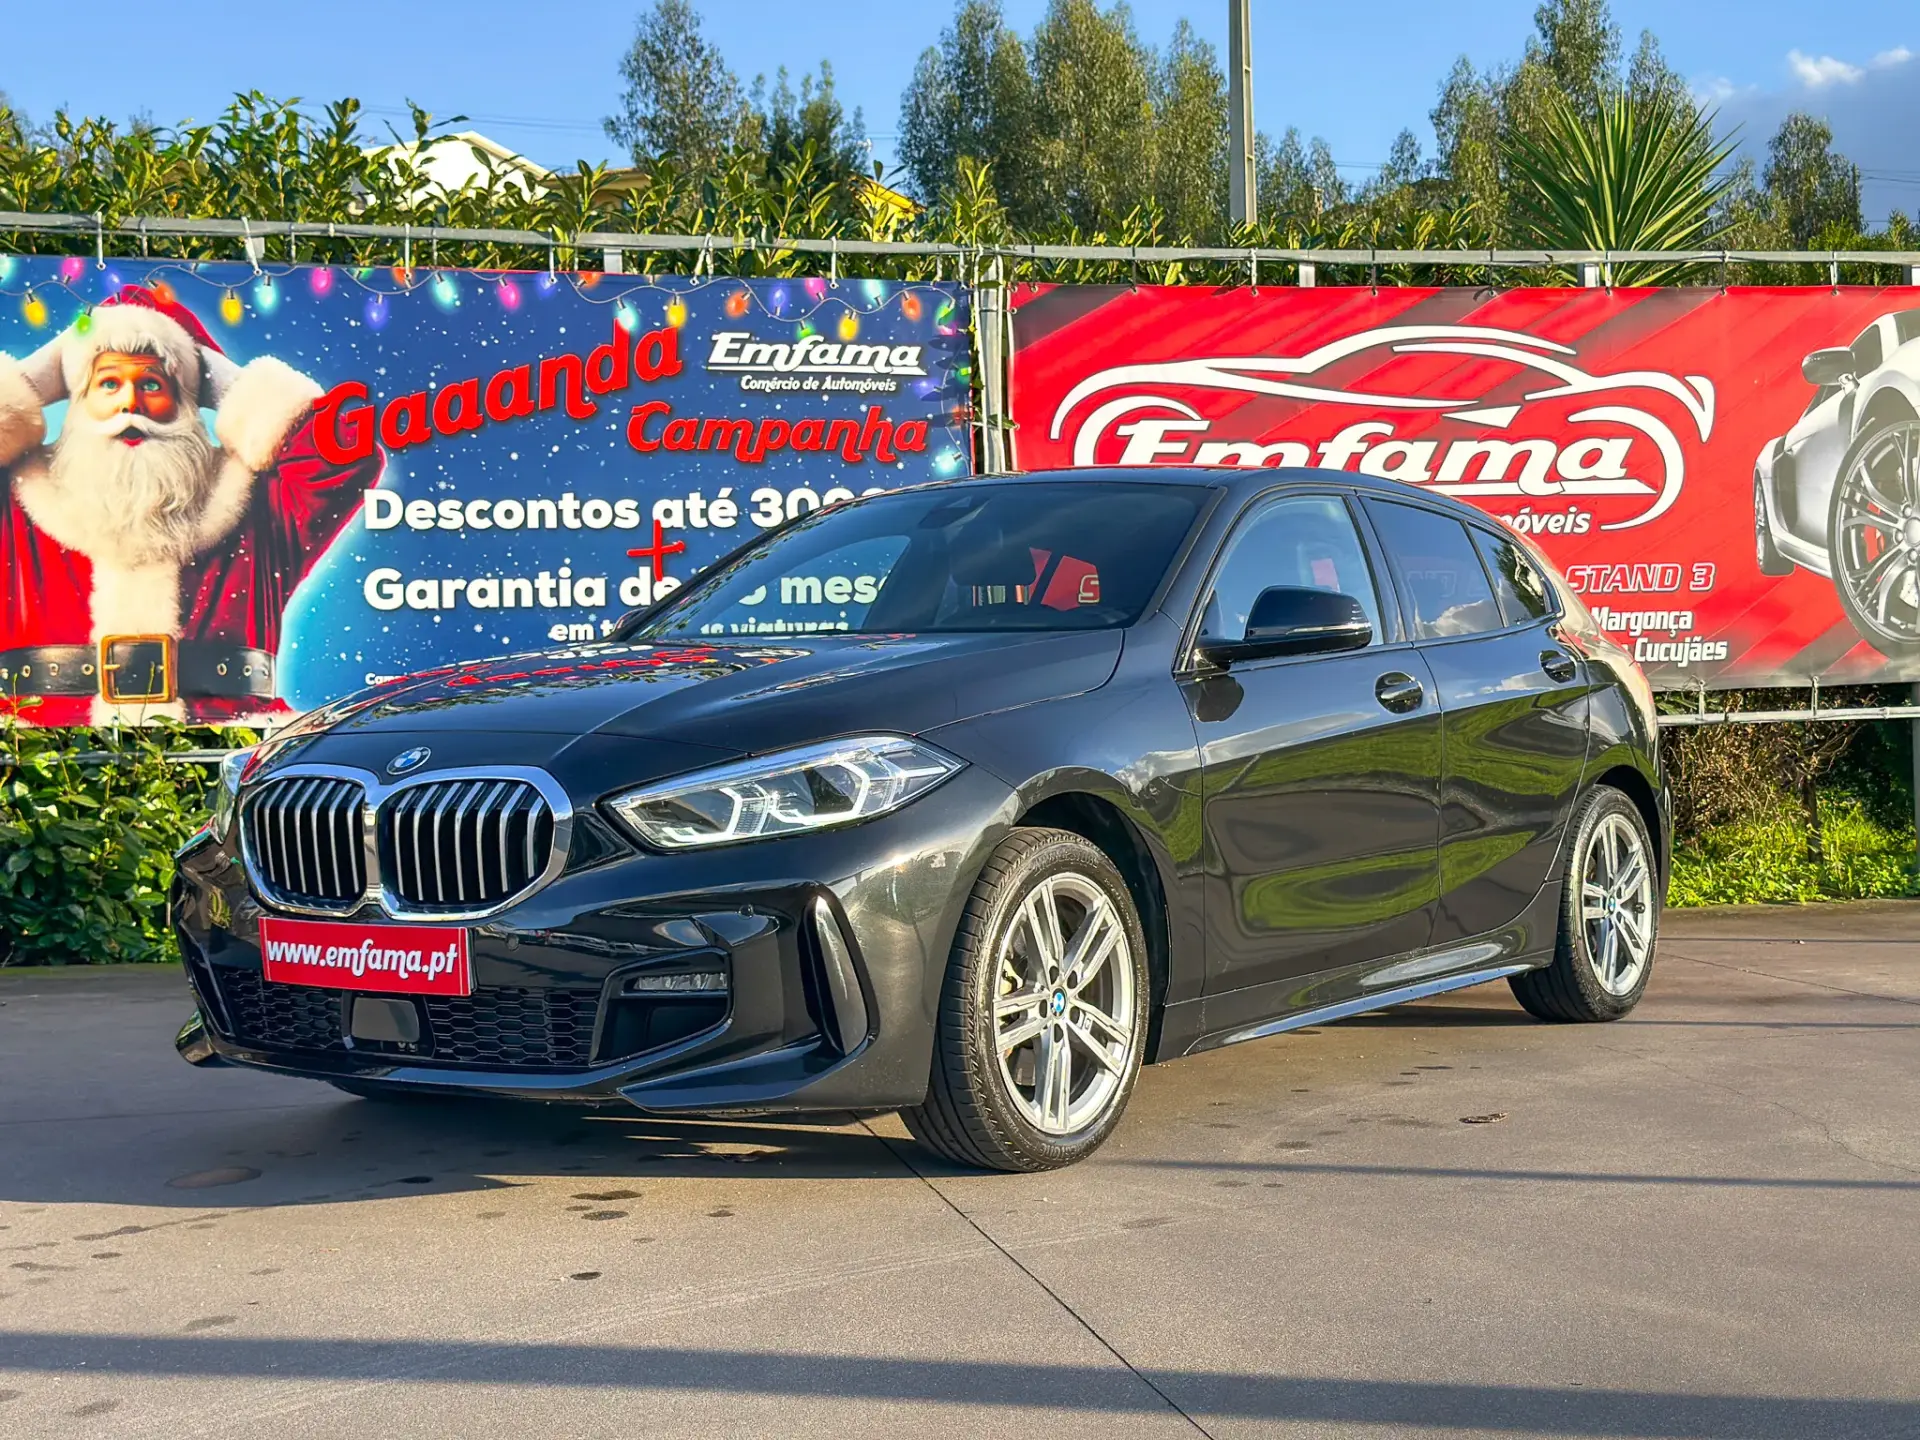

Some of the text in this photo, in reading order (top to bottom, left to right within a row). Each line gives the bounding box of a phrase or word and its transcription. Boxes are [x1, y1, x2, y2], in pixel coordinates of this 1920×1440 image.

[708, 332, 922, 372] Emfama
[312, 318, 684, 465] Gaaanda
[740, 374, 897, 393] Comércio de Automóveis
[626, 401, 928, 464] Campanha
[363, 488, 641, 530] Descontos
[651, 487, 739, 529] até
[363, 566, 606, 611] Garantia
[780, 575, 889, 605] mes
[1565, 562, 1716, 595] STAND 3
[551, 623, 595, 642] em
[1634, 636, 1728, 668] Cucujães
[267, 938, 458, 982] www.emfama.pt
